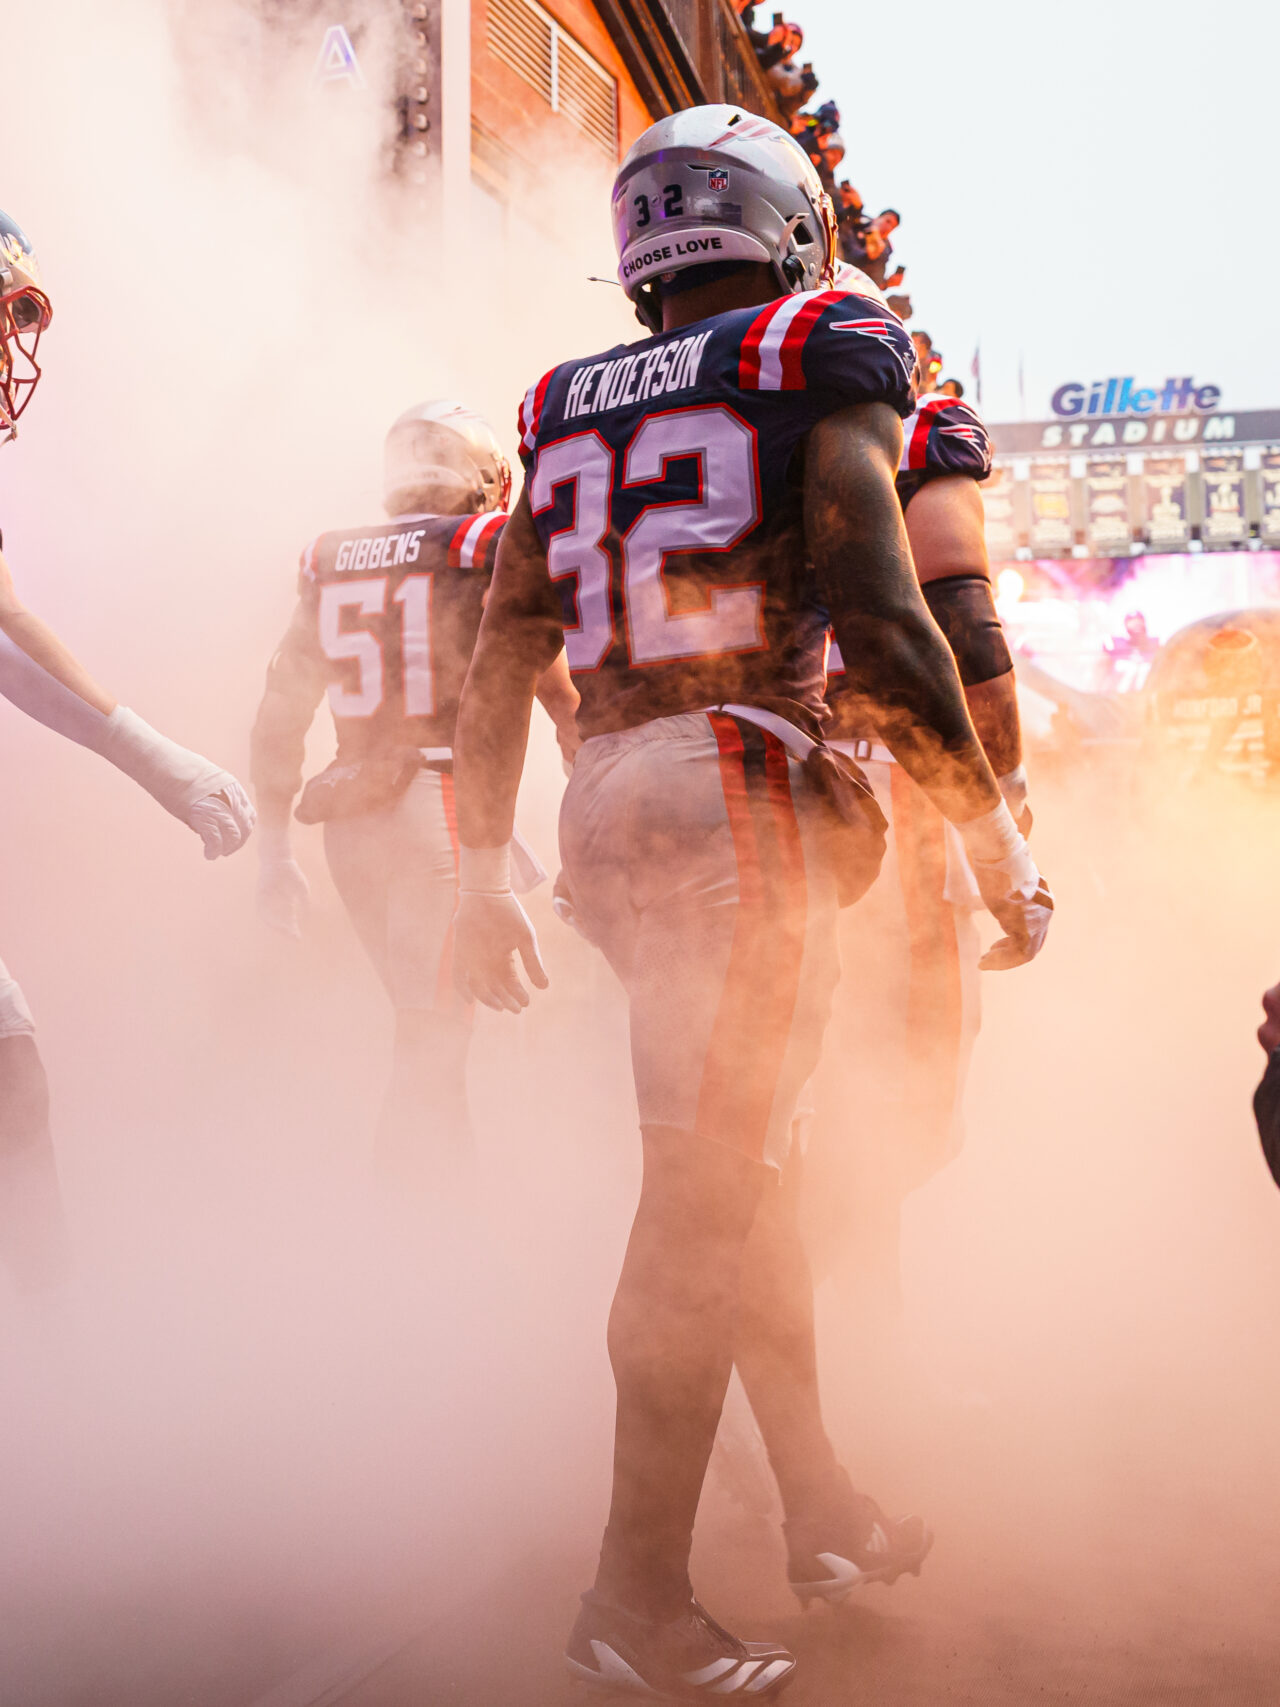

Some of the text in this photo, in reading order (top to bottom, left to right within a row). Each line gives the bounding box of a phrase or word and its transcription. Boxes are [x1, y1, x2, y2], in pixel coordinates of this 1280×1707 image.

[710, 178, 727, 190] NFL
[623, 246, 672, 278] CHOOSE
[676, 237, 723, 255] LOVE
[563, 330, 714, 421] HENDERSON
[1051, 377, 1221, 417] Gillette
[1041, 416, 1236, 447] STADIUM
[334, 529, 426, 571] GIBBENS
[531, 402, 770, 675] 32
[319, 572, 437, 718] 51
